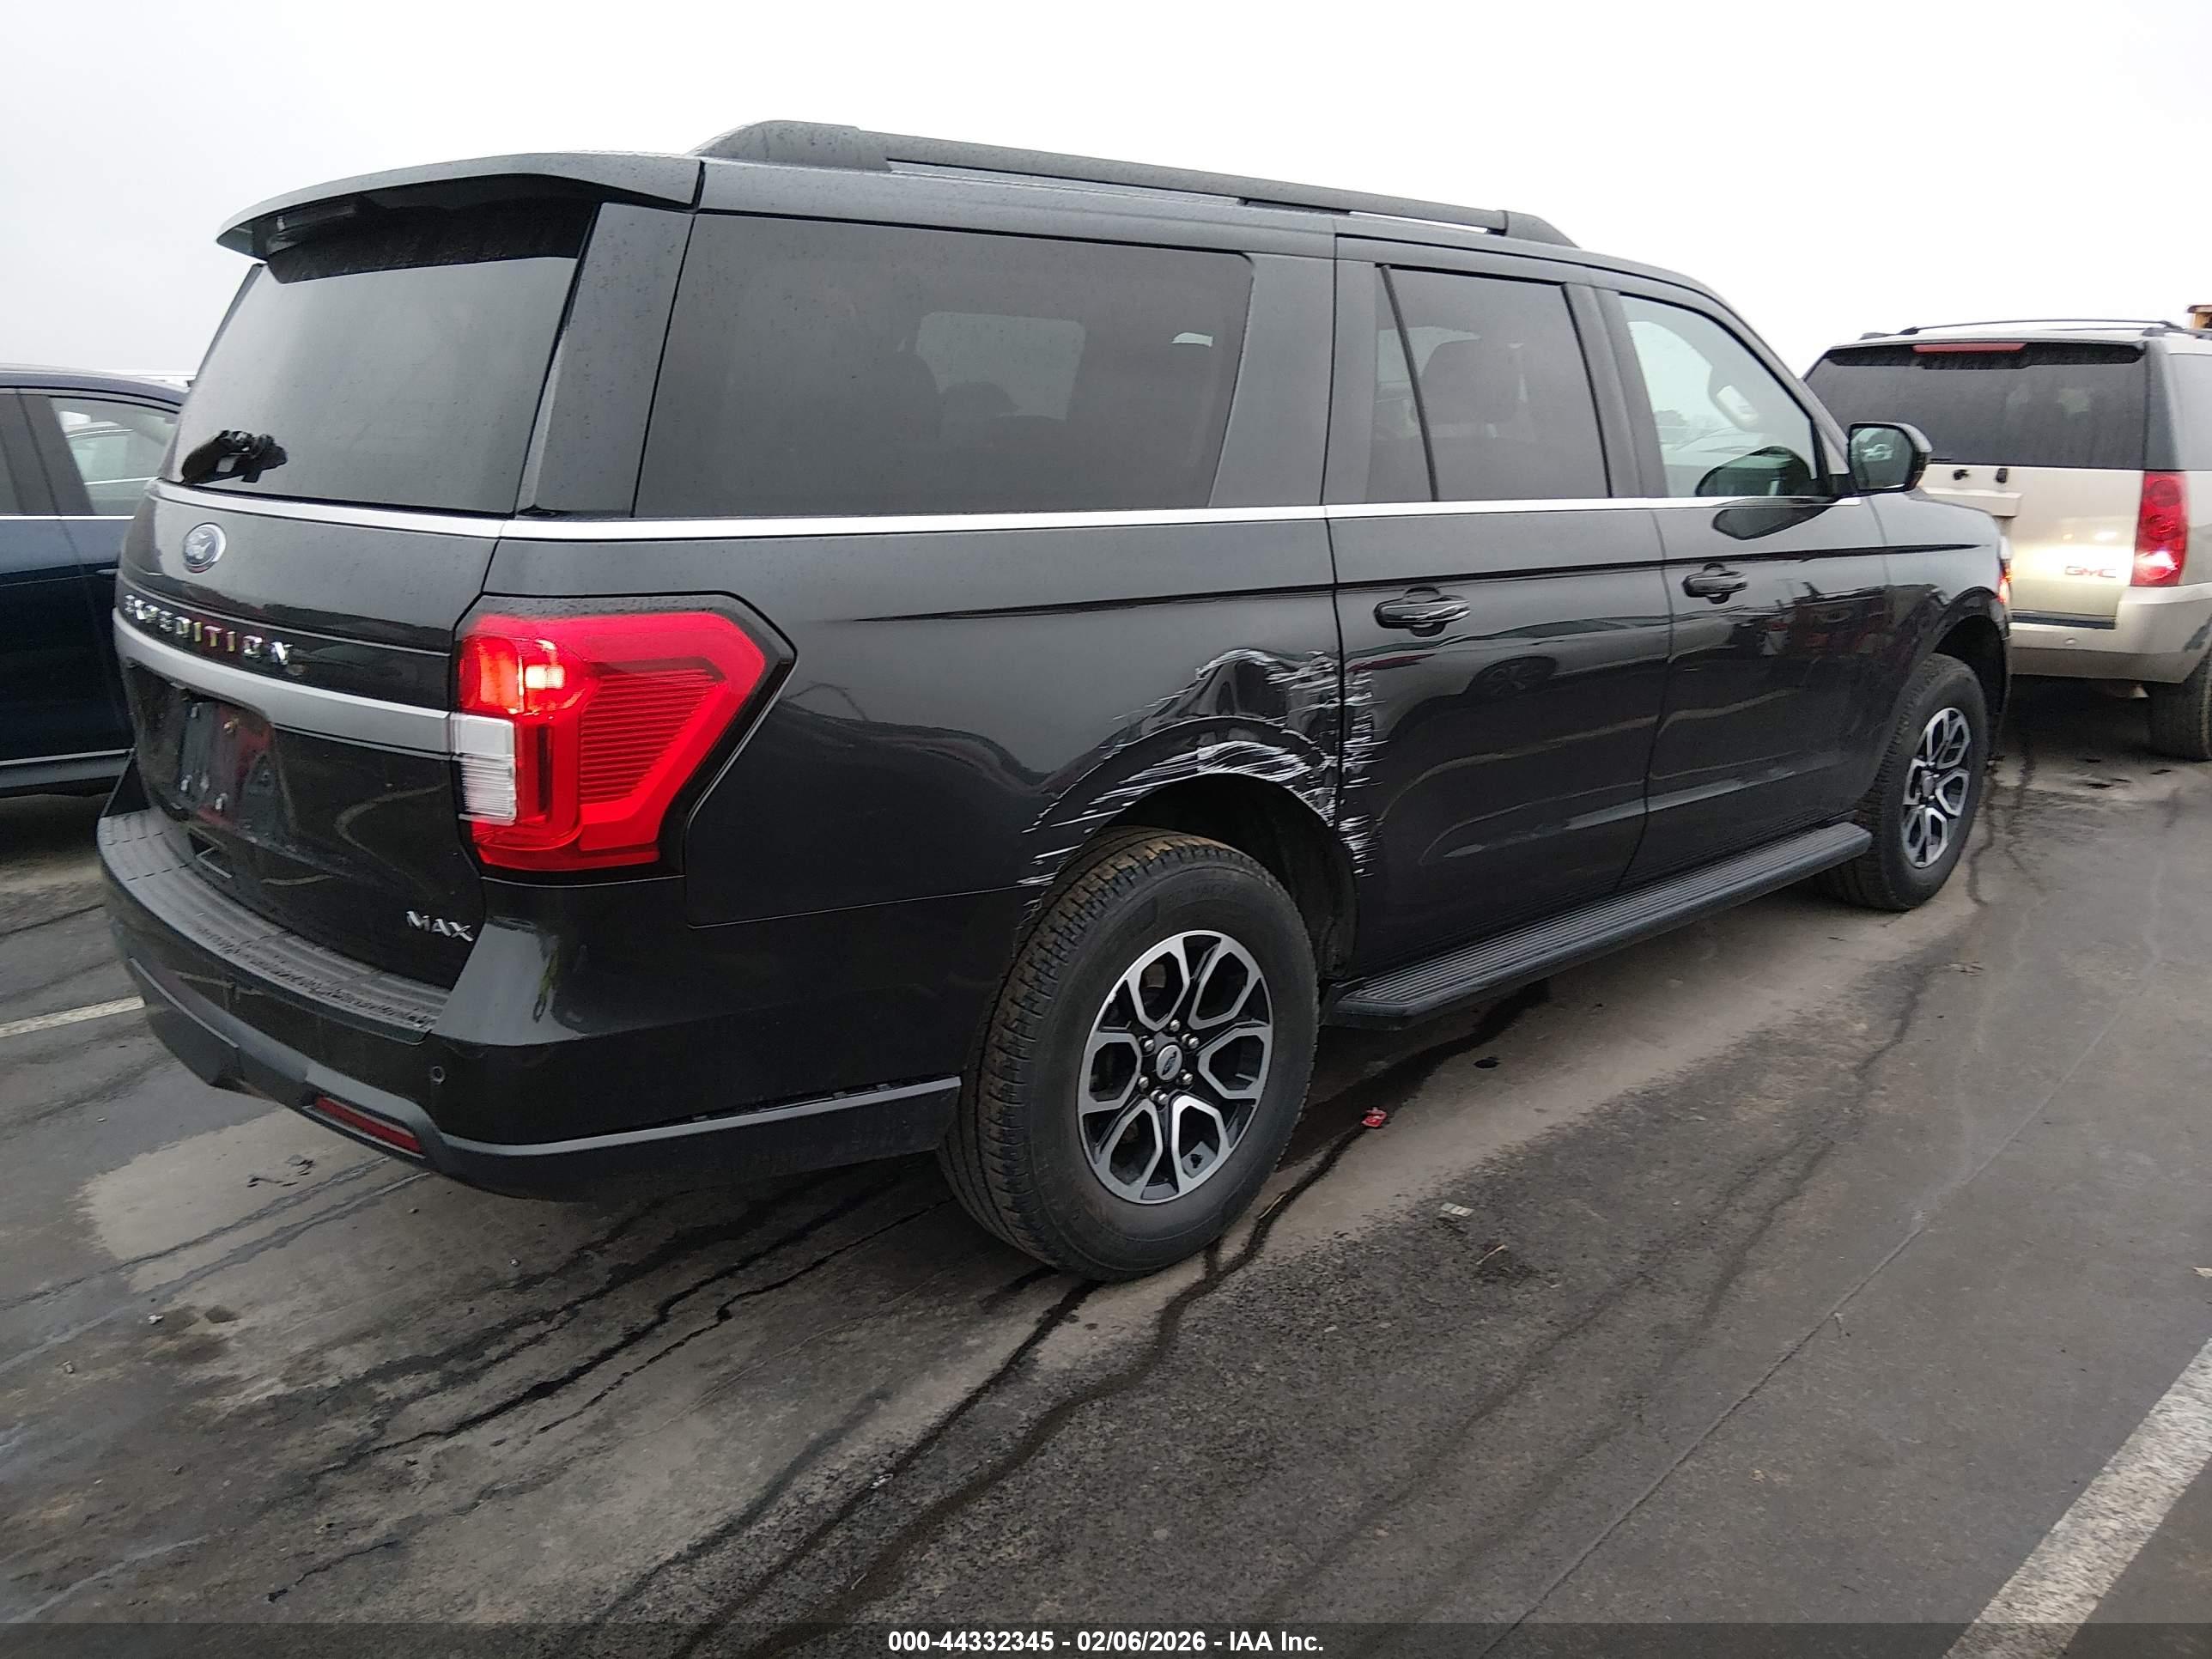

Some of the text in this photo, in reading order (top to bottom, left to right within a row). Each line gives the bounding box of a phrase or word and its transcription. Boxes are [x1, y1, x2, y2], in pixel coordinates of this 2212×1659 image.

[2064, 565, 2117, 579] GMC
[125, 594, 293, 665] EXPEDITION
[405, 910, 474, 942] MAX
